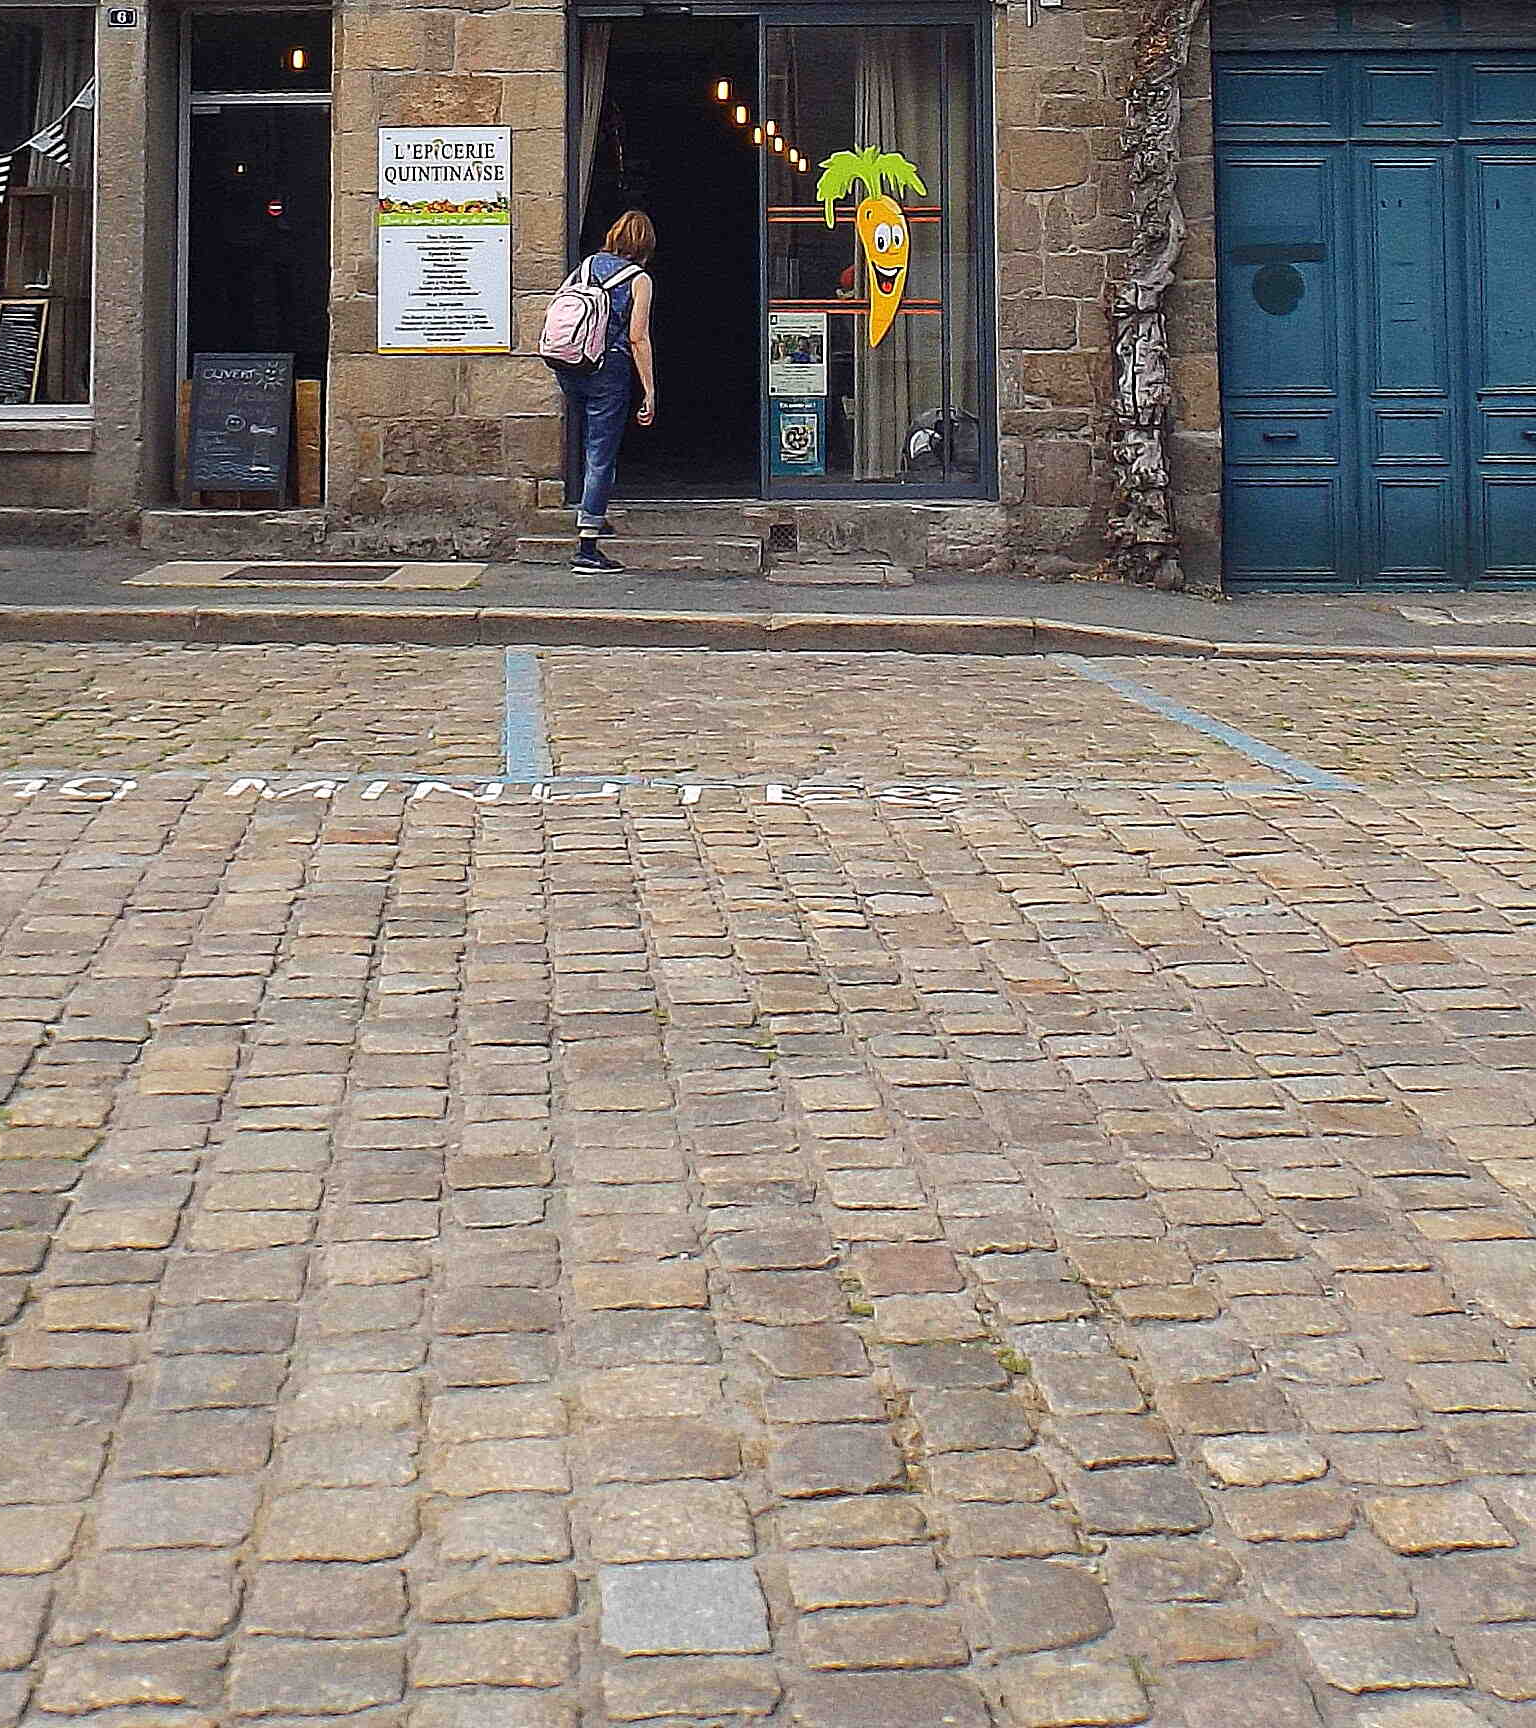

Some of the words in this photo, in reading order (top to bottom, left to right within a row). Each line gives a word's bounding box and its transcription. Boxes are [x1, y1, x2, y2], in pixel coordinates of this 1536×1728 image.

[116, 11, 127, 23] 6
[394, 139, 496, 160] L'EPICERIE
[384, 161, 505, 185] QUINTINAISE
[203, 368, 256, 380] OUVERT
[223, 774, 965, 805] MINUTES
